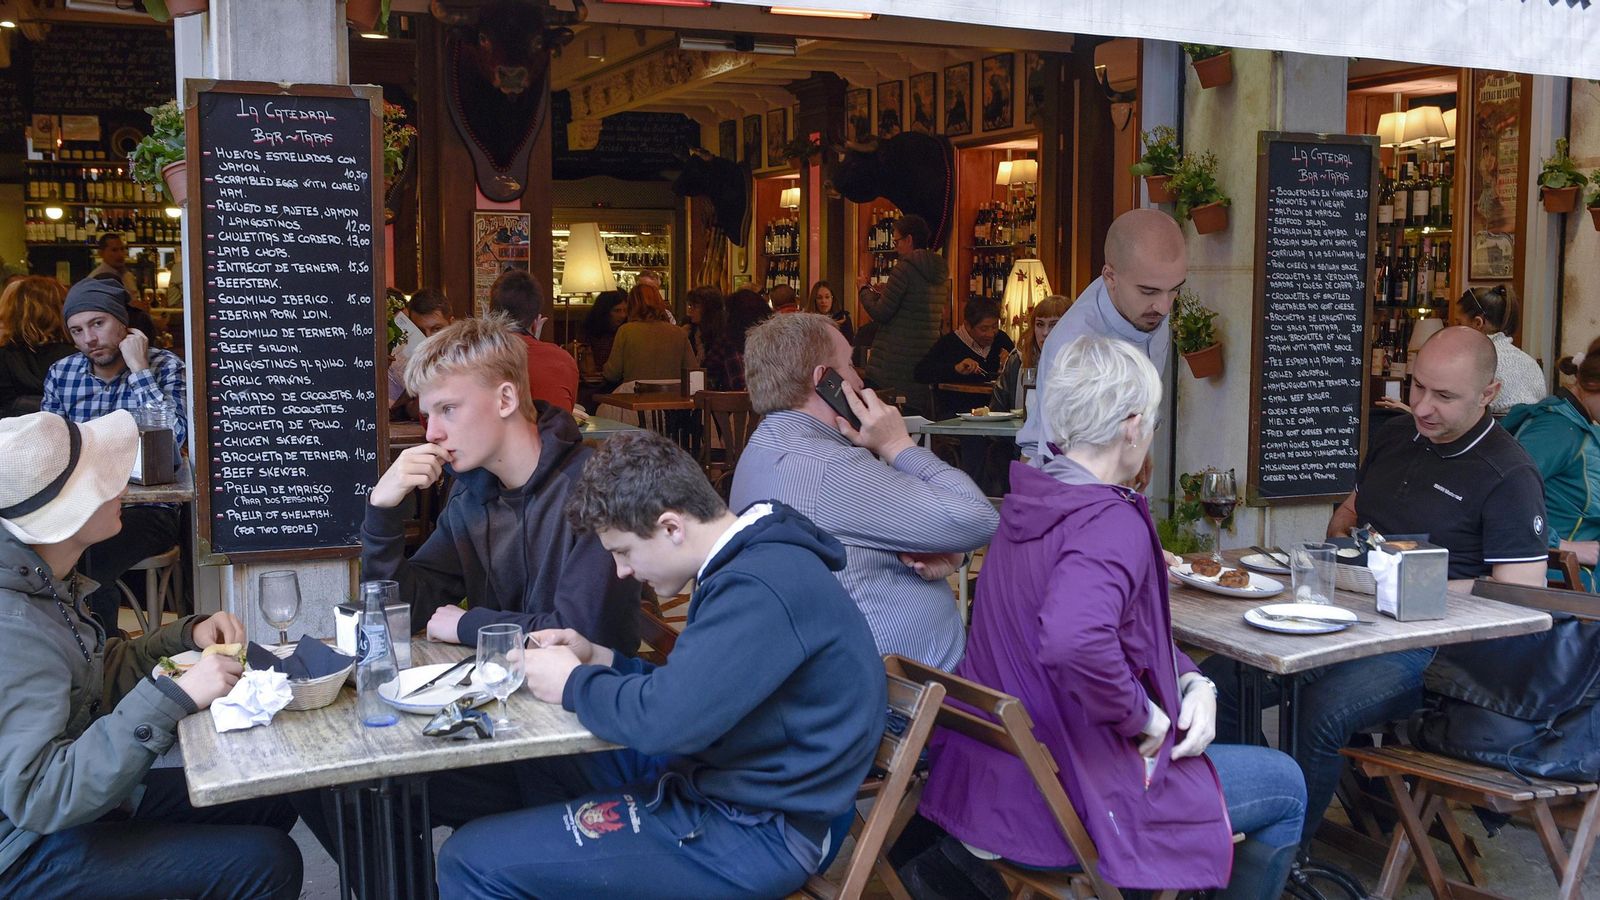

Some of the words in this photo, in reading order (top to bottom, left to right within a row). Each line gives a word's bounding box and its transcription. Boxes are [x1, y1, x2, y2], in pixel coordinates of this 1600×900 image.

[237, 99, 259, 123] LA
[265, 102, 336, 124] CATEDRAL
[251, 128, 283, 146] BAR
[216, 147, 261, 160] HUEVOS
[266, 152, 333, 163] ESTRELLADOS
[338, 156, 356, 164] CON
[1292, 146, 1307, 168] LA
[1311, 148, 1352, 168] CATEDRAL
[219, 162, 266, 173] JAMON.
[345, 168, 367, 181] 10,50
[1298, 169, 1318, 185] BAR
[215, 175, 273, 186] SCRAMBLED
[276, 179, 298, 188] EGGS
[303, 179, 327, 189] WITH
[332, 182, 360, 191] CURED
[220, 189, 247, 197] HAM.
[265, 204, 278, 214] DE
[324, 208, 358, 220] JAMON
[217, 216, 224, 226] Y
[229, 217, 302, 230] LANGOSTINOS.
[345, 220, 370, 234] 12,00
[218, 232, 279, 246] CHULETITAS
[283, 234, 295, 242] DE
[298, 234, 343, 245] CORDERO.
[347, 235, 369, 248] 13,00
[218, 246, 249, 256] LAMB
[255, 249, 290, 257] CHOPS.
[217, 261, 271, 272] ENTRECOT
[275, 263, 289, 273] DE
[291, 263, 342, 274] TERNERA.
[348, 261, 369, 274] 15,50
[215, 277, 282, 289] BEEFSTEAK.
[218, 293, 276, 304] SOLOMILLO
[282, 295, 333, 305] IBERICO.
[347, 294, 371, 305] 15,00
[219, 310, 267, 321] IBERIAN
[270, 310, 297, 319] PORK
[303, 310, 331, 319] LOIN.
[220, 327, 278, 339] SOLOMILLO
[282, 328, 295, 338] DE
[297, 327, 347, 339] TERNERA.
[352, 324, 372, 336] 18,00
[1287, 325, 1307, 333] SALSA
[218, 342, 253, 353] BEEF
[259, 344, 301, 353] SIRLOIN.
[219, 358, 297, 372] LANGOSTINOS
[301, 360, 313, 372] AL
[316, 359, 346, 372] AJILLO.
[354, 357, 373, 369] 10,00
[221, 376, 262, 387] GARLIC
[266, 376, 314, 385] PRAWNS.
[221, 390, 275, 404] VARIADO
[282, 393, 296, 401] DE
[301, 390, 354, 400] CROQUETAS.
[356, 389, 375, 401] 10,50
[222, 405, 276, 419] ASSORTED
[283, 404, 347, 414] CROQUETTES.
[220, 420, 284, 433] BROCHETA
[288, 420, 303, 429] DE
[309, 419, 343, 429] POLLO.
[355, 419, 375, 431] 12,00
[223, 436, 269, 447] CHICKEN
[276, 436, 323, 446] SKEWER.
[221, 452, 283, 465] BROCHETA
[286, 452, 297, 460] DE
[300, 450, 350, 461] TERNERA.
[354, 448, 376, 462] 14,00
[222, 467, 254, 478] BEEF
[259, 467, 309, 477] SKEWER.
[224, 481, 267, 494] PAELLA
[289, 485, 334, 495] MARISCO.
[234, 496, 261, 507] (PARA
[266, 496, 280, 504] DOS
[283, 494, 329, 505] PERSONAS)
[226, 510, 262, 521] PAELLA
[266, 510, 278, 519] OF
[282, 510, 332, 518] SHELLFISH.
[234, 525, 255, 537] (FOR
[282, 524, 318, 536] PEOPLE)
